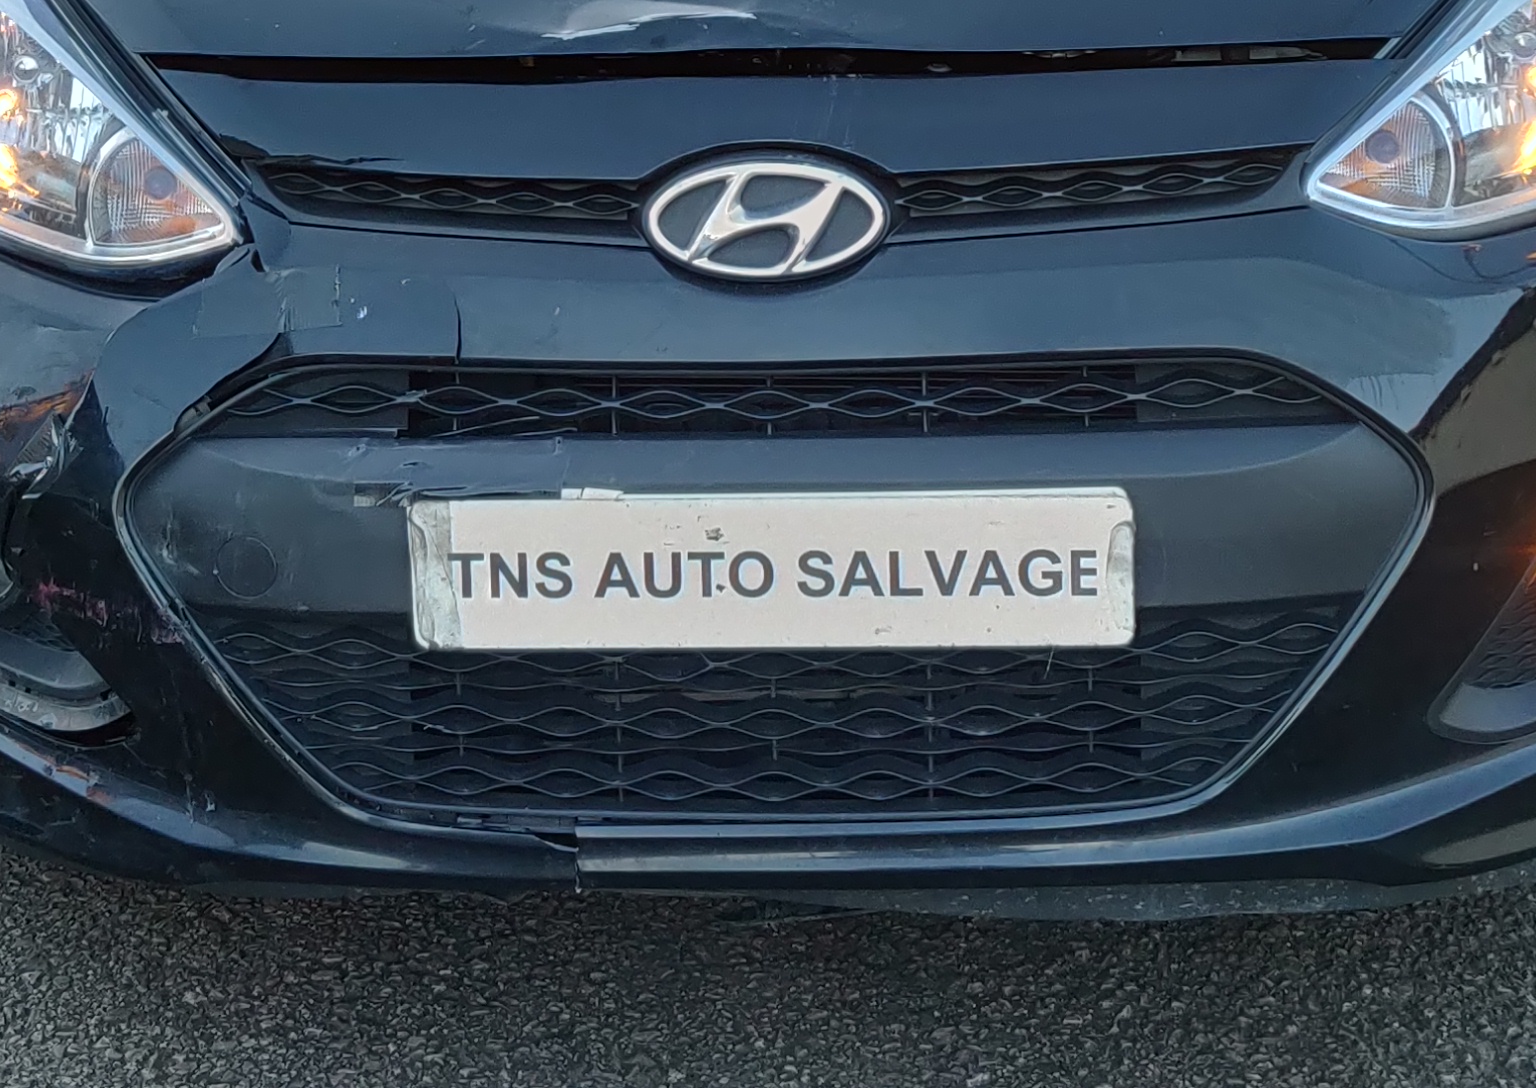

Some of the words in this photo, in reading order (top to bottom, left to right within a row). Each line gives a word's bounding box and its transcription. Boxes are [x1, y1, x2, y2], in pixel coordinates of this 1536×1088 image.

[447, 551, 573, 599] TNS
[594, 550, 775, 599] AUTO
[797, 548, 1098, 598] SALVAGE
